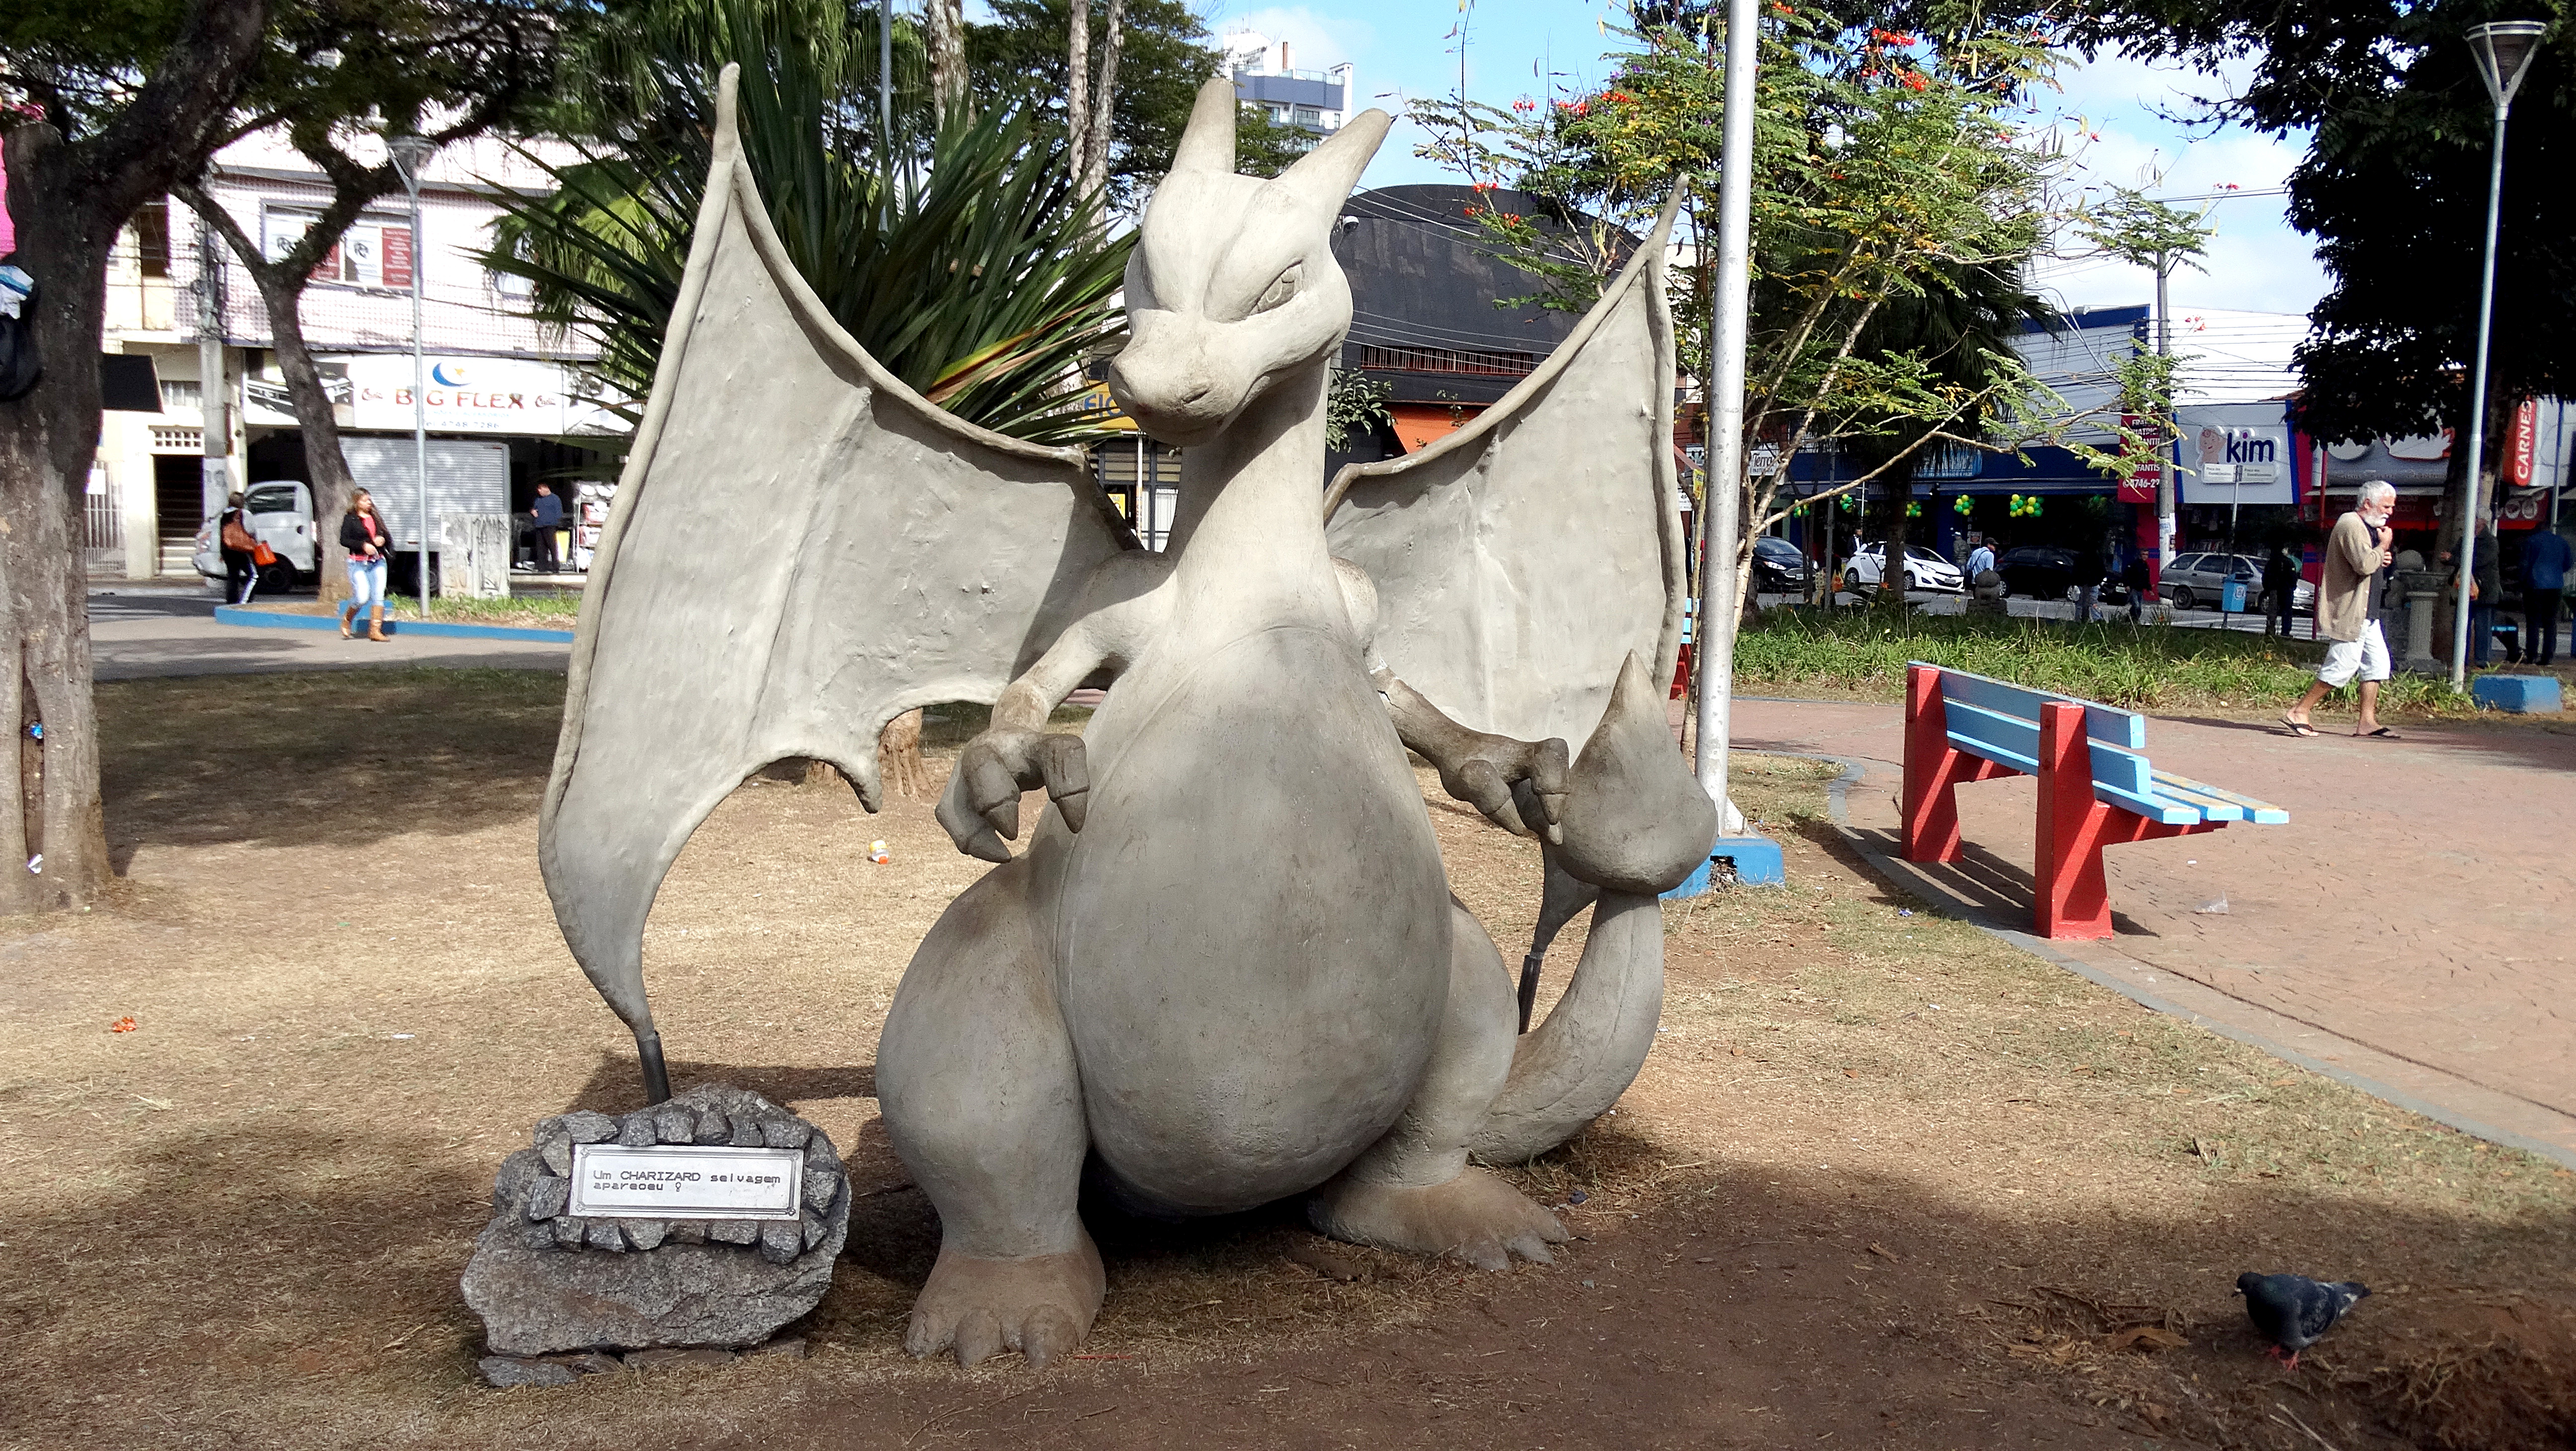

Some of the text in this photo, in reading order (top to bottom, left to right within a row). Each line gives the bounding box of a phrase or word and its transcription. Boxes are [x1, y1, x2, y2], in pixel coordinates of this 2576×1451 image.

[396, 389, 444, 405] BG
[457, 392, 524, 409] FLEX
[2227, 432, 2274, 463] kim
[2517, 400, 2532, 479] CARNES
[593, 1170, 781, 1184] Um CHARIZARD selvagem
